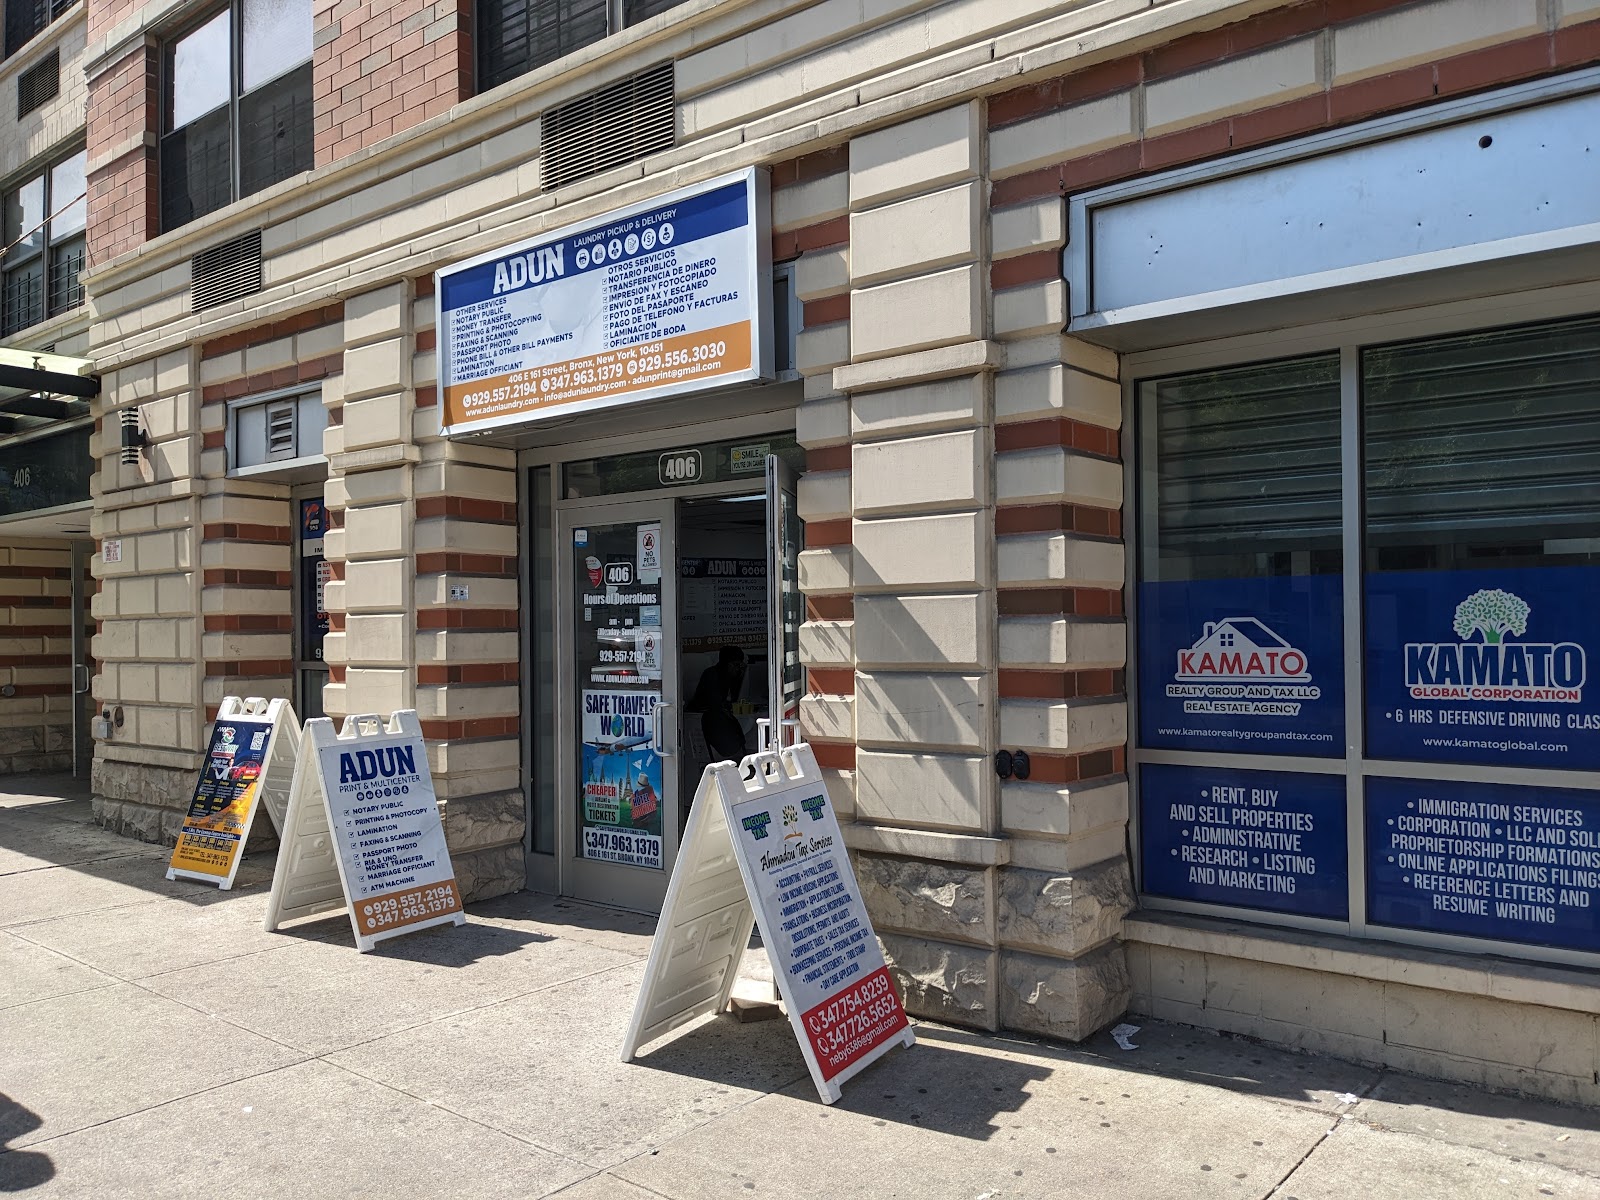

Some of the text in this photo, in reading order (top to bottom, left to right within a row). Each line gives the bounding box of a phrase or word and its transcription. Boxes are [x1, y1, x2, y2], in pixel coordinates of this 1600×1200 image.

[573, 208, 676, 247] LAUNDRY PICKUP DELIVERY
[493, 244, 563, 293] ADUN
[607, 249, 675, 274] OTROS SERVICIOS
[608, 257, 716, 292] TRANSFERENCIA DINERO
[608, 268, 641, 283] NOTARIO
[658, 267, 716, 288] FOTOCOPIADO
[645, 279, 708, 302] FAX ESCANEO
[455, 296, 506, 316] OTHER SERVICES
[456, 306, 503, 324] NOTARY PUBLIC
[609, 292, 693, 320] FOTO DEL PASAPORTE
[609, 318, 630, 329] PAGO
[694, 291, 737, 308] FACTURAS
[456, 312, 511, 332] MONEY TRANSFER
[456, 313, 541, 341] PRINTING PHOTOCOPYING
[456, 328, 518, 349] FAXING SCANNING
[609, 332, 649, 347] OFICIANTE
[663, 324, 685, 335] BODA
[456, 338, 511, 357] PASSPORT PHOTO
[456, 332, 573, 365] PHONE BILL OTHER BILL PAYMENTS
[456, 359, 494, 373] LAMINATION
[457, 361, 522, 380] MARRIAGE OFFICIANT
[471, 341, 725, 405] 929.557.2194 347.963.1379 929.556.3030
[508, 342, 663, 383] 406 161 Street, Bronx, New York, 10451
[465, 361, 720, 416] www.adunlaundry.com info@adunlaundry.com adunprint@gmail.com
[741, 450, 759, 460] SMILE
[14, 467, 30, 487] 406
[666, 457, 696, 479] 406
[609, 567, 629, 582] 406
[707, 560, 737, 575] ADUN
[584, 592, 657, 605] Hours Operations
[599, 650, 646, 662] 929-557-2194
[1181, 652, 1304, 675] KAMATO
[1405, 643, 1585, 689] KAMATO
[1168, 686, 1318, 697] REALTY GROUP AND TAX LLC
[1412, 687, 1579, 700] GLOBAL CORPORATION
[586, 694, 656, 715] SAFE TRAVELS
[1186, 703, 1299, 714] REAL ESTATE AGENCY
[1395, 708, 1560, 728] 6 HRS DEFENSIVE DRIVING
[1158, 727, 1333, 742] www.kamatorealtygroupandtax.com
[1423, 737, 1568, 752] www.kamatoglobal.com
[340, 745, 415, 782] ADUN
[339, 774, 420, 792] PRINT MULTICENTER
[587, 784, 616, 797] CHEAPER
[352, 800, 403, 814] NOTARY PUBLIC
[800, 794, 826, 812] INCOME
[1212, 786, 1279, 807] RENT, BUY
[354, 807, 427, 825] PRINTING PHOTOCOPY
[589, 809, 616, 821] TICKETS
[741, 811, 771, 831] INCOME
[808, 806, 824, 821] TAX
[1170, 804, 1314, 831] AND SELL PROPERTIES
[1418, 798, 1583, 827] IMMIGRATION SERVICES
[357, 824, 397, 836] LAMINATION
[359, 830, 421, 847] FAXING SCANNING
[750, 824, 769, 840] TAX
[1192, 826, 1301, 852] ADMINISTRATIVE
[1398, 815, 1490, 838] CORPORATION
[1506, 824, 1532, 842] LLC
[1536, 827, 1566, 845] AND
[362, 842, 417, 858] PASSPORT PHOTO
[591, 832, 659, 857] 347.963.1379
[760, 844, 795, 871] Ahmadou
[795, 841, 808, 857] Tax
[809, 835, 832, 852] Services
[1391, 833, 1600, 869] PROPRIETORSHIP FORMATIONS
[365, 854, 423, 871] MONEY TRANSFER
[382, 854, 397, 862] UNO
[587, 848, 597, 857] 406
[601, 851, 610, 859] 161
[644, 857, 659, 866] 10451
[1181, 845, 1315, 875] RESEARCH LISTING
[367, 860, 434, 880] MARRIAGE OFFICIANT
[1398, 852, 1547, 884] ONLINE APPLICATIONS
[370, 876, 415, 891] ATM MACHINE
[1188, 866, 1296, 894] AND MARKETING
[1414, 873, 1590, 908] REFERENCE LETTERS AND
[373, 885, 452, 913] 929.557.2194
[1433, 894, 1555, 924] RESUME WRITING
[376, 897, 454, 925] 347.963.1379
[818, 975, 888, 1028] 347.754.8239
[826, 993, 896, 1049] 347.726.5652
[829, 1015, 897, 1065] neby6386@gmail.com
